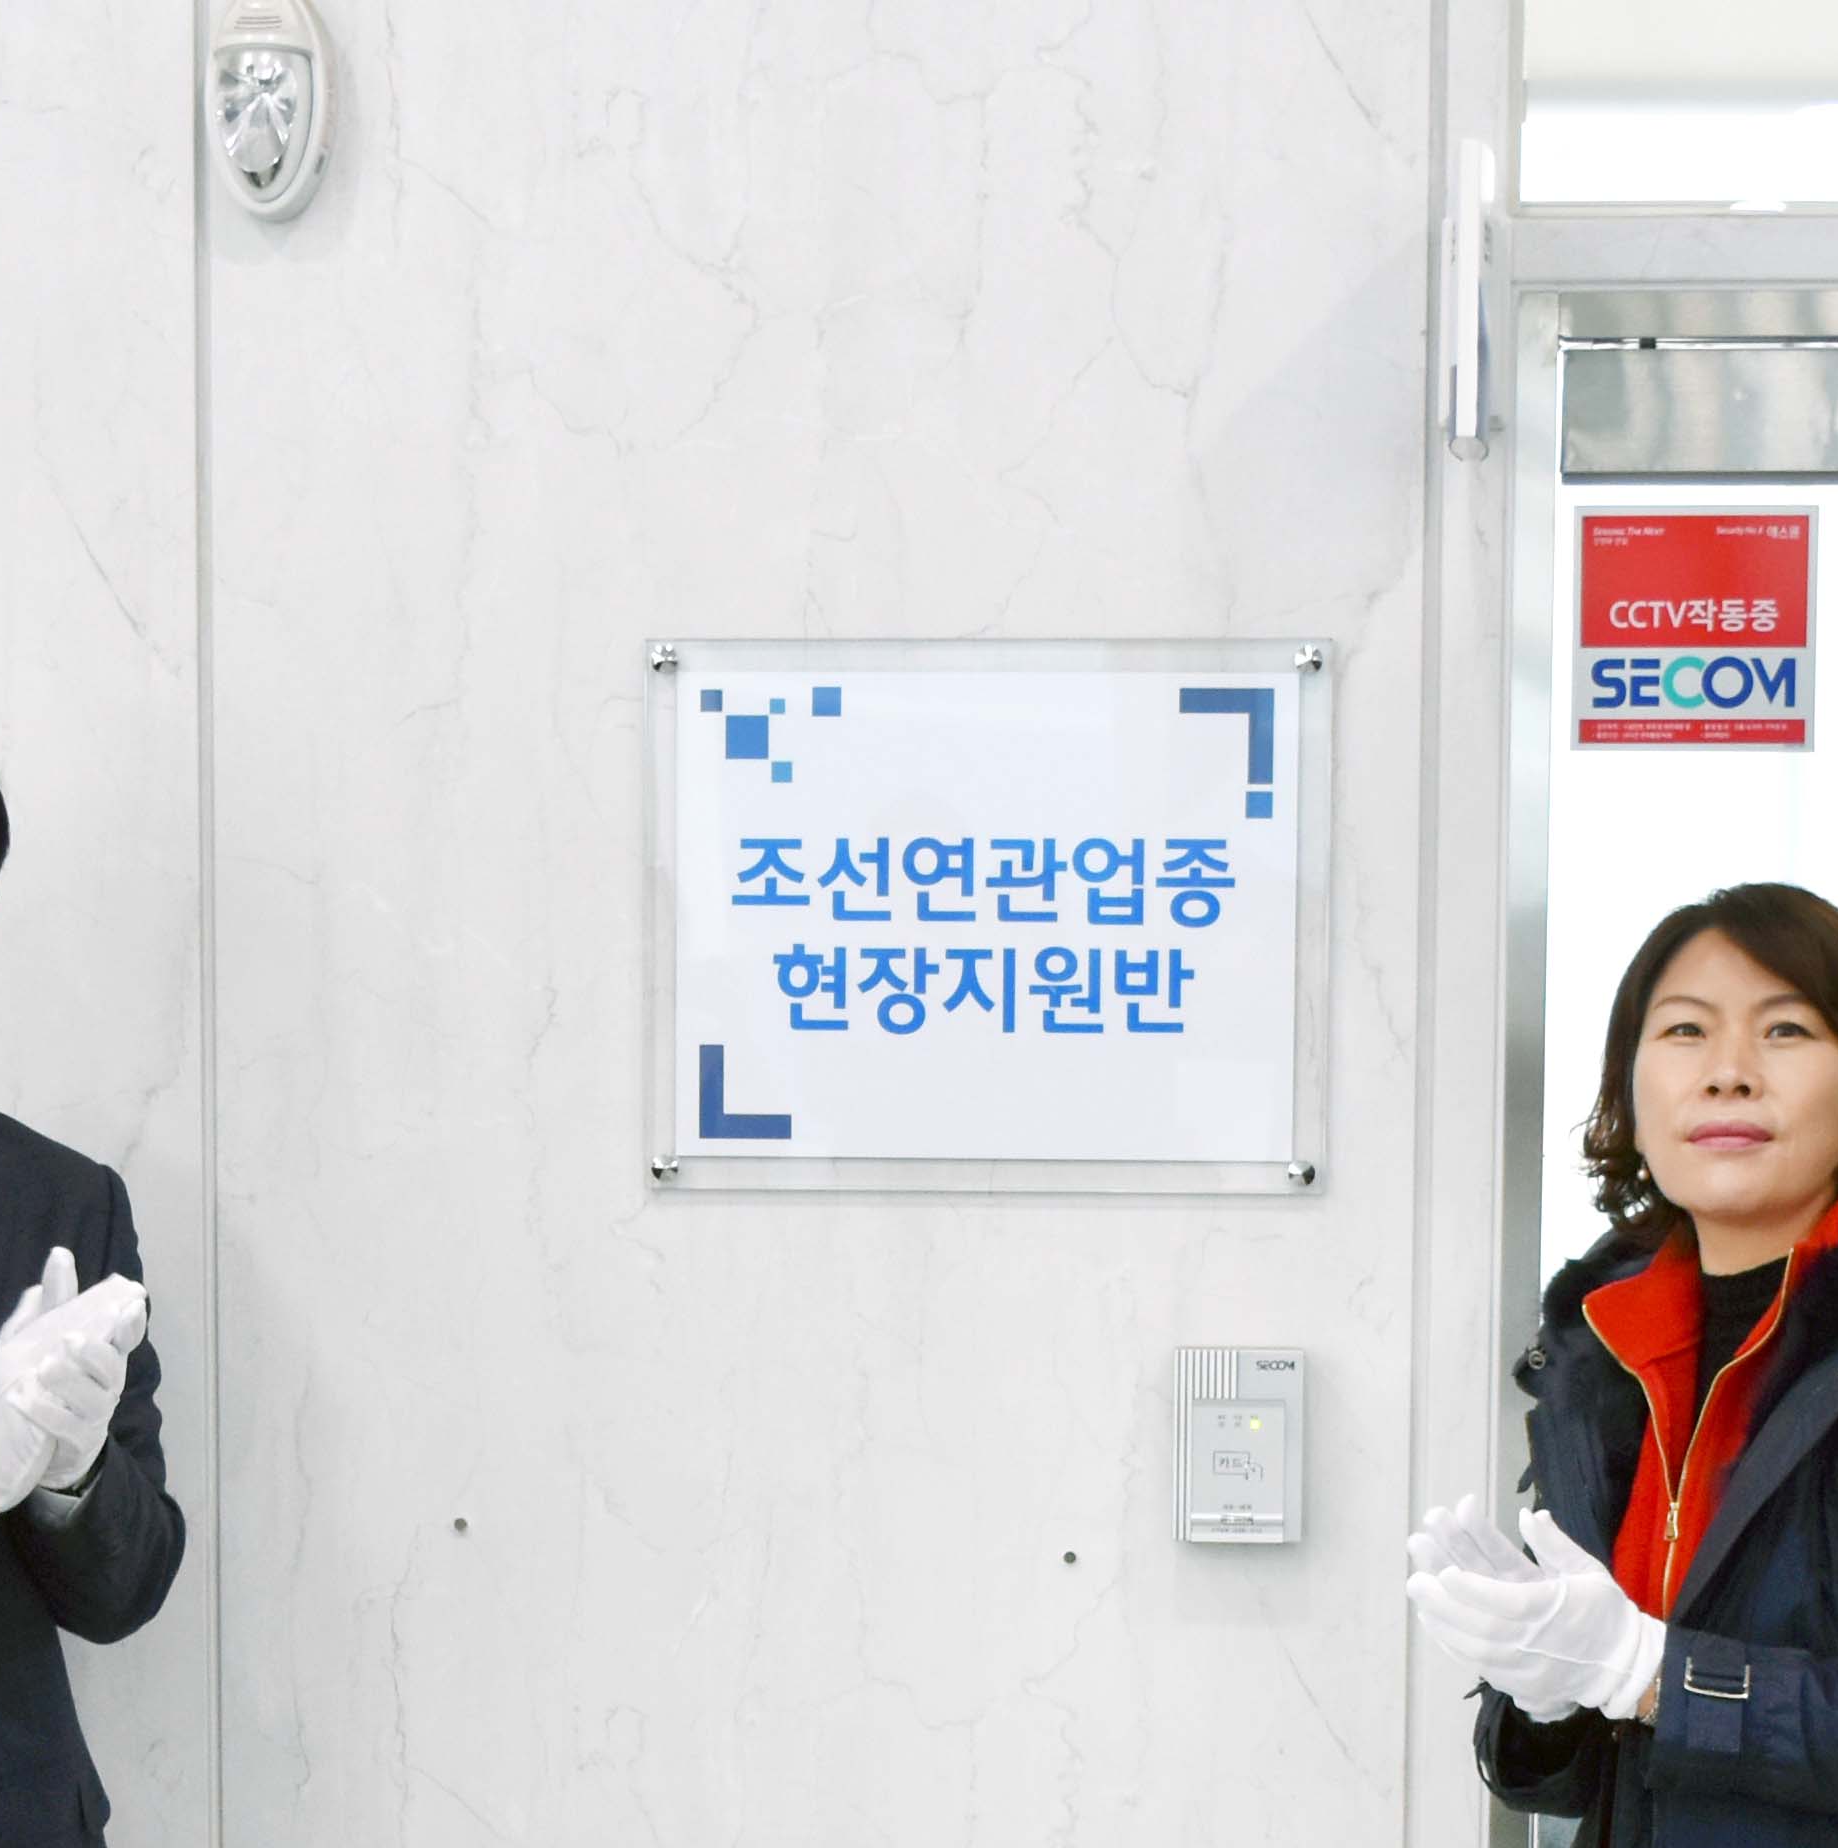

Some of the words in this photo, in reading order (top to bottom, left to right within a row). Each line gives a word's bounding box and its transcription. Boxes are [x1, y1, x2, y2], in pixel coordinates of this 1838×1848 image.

[1609, 598, 1778, 632] CCTV작동중
[1591, 656, 1796, 709] SECOM
[731, 836, 1236, 928] 조선연관업종
[773, 943, 1194, 1035] 현장지원반
